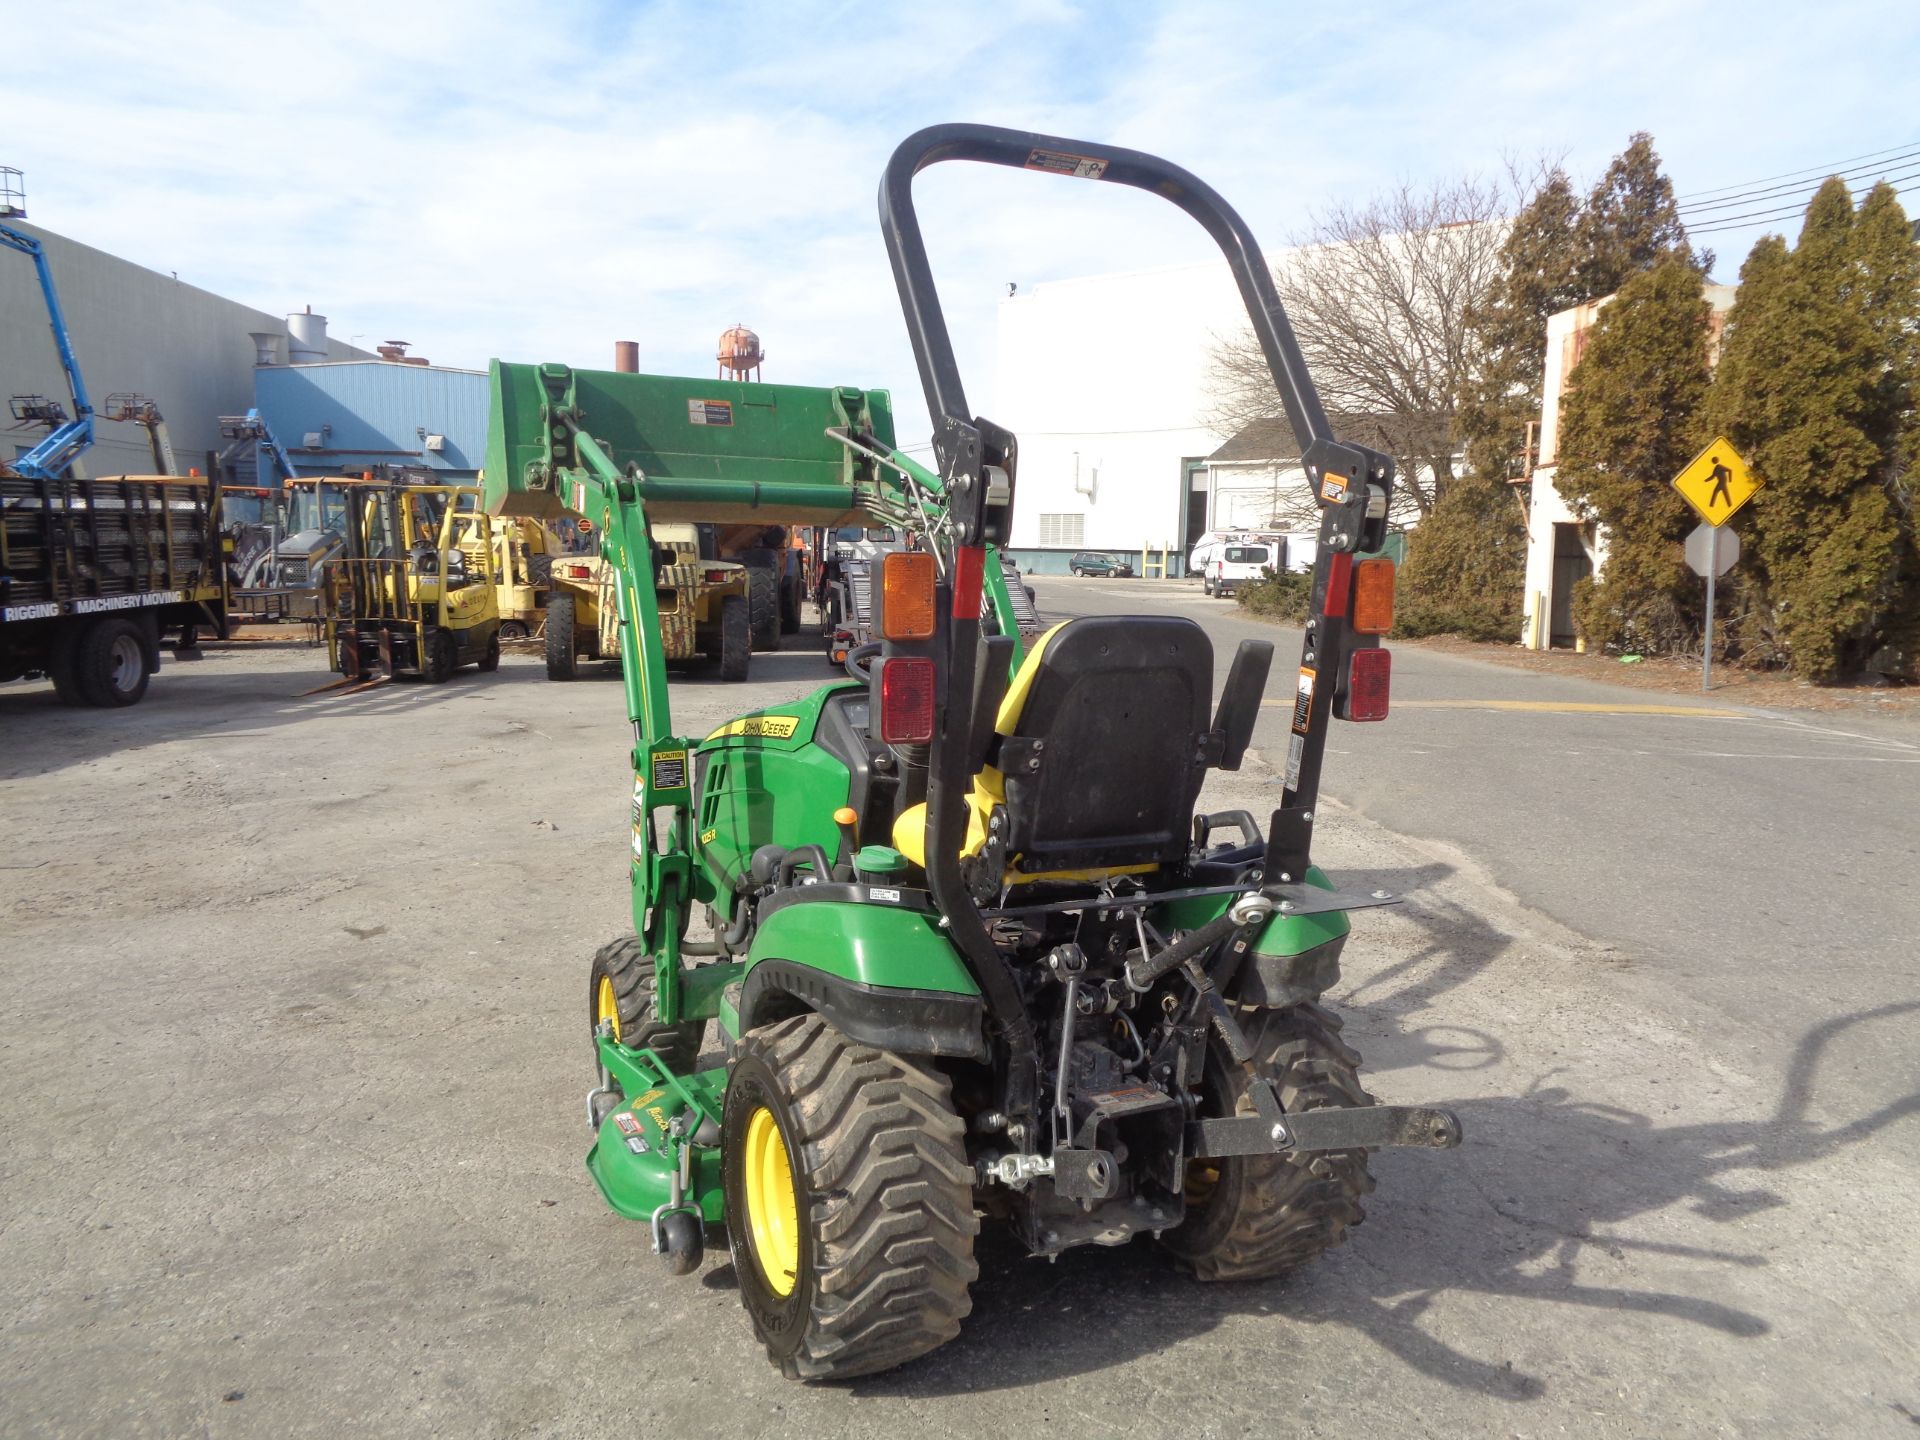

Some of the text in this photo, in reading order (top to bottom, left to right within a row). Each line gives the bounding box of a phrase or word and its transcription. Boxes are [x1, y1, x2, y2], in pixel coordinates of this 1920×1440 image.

[77, 591, 182, 613] MACHINERY MOVING
[5, 603, 59, 621] RIGGING
[740, 720, 791, 735] JOHN DEERE
[661, 752, 683, 760] CAUTION
